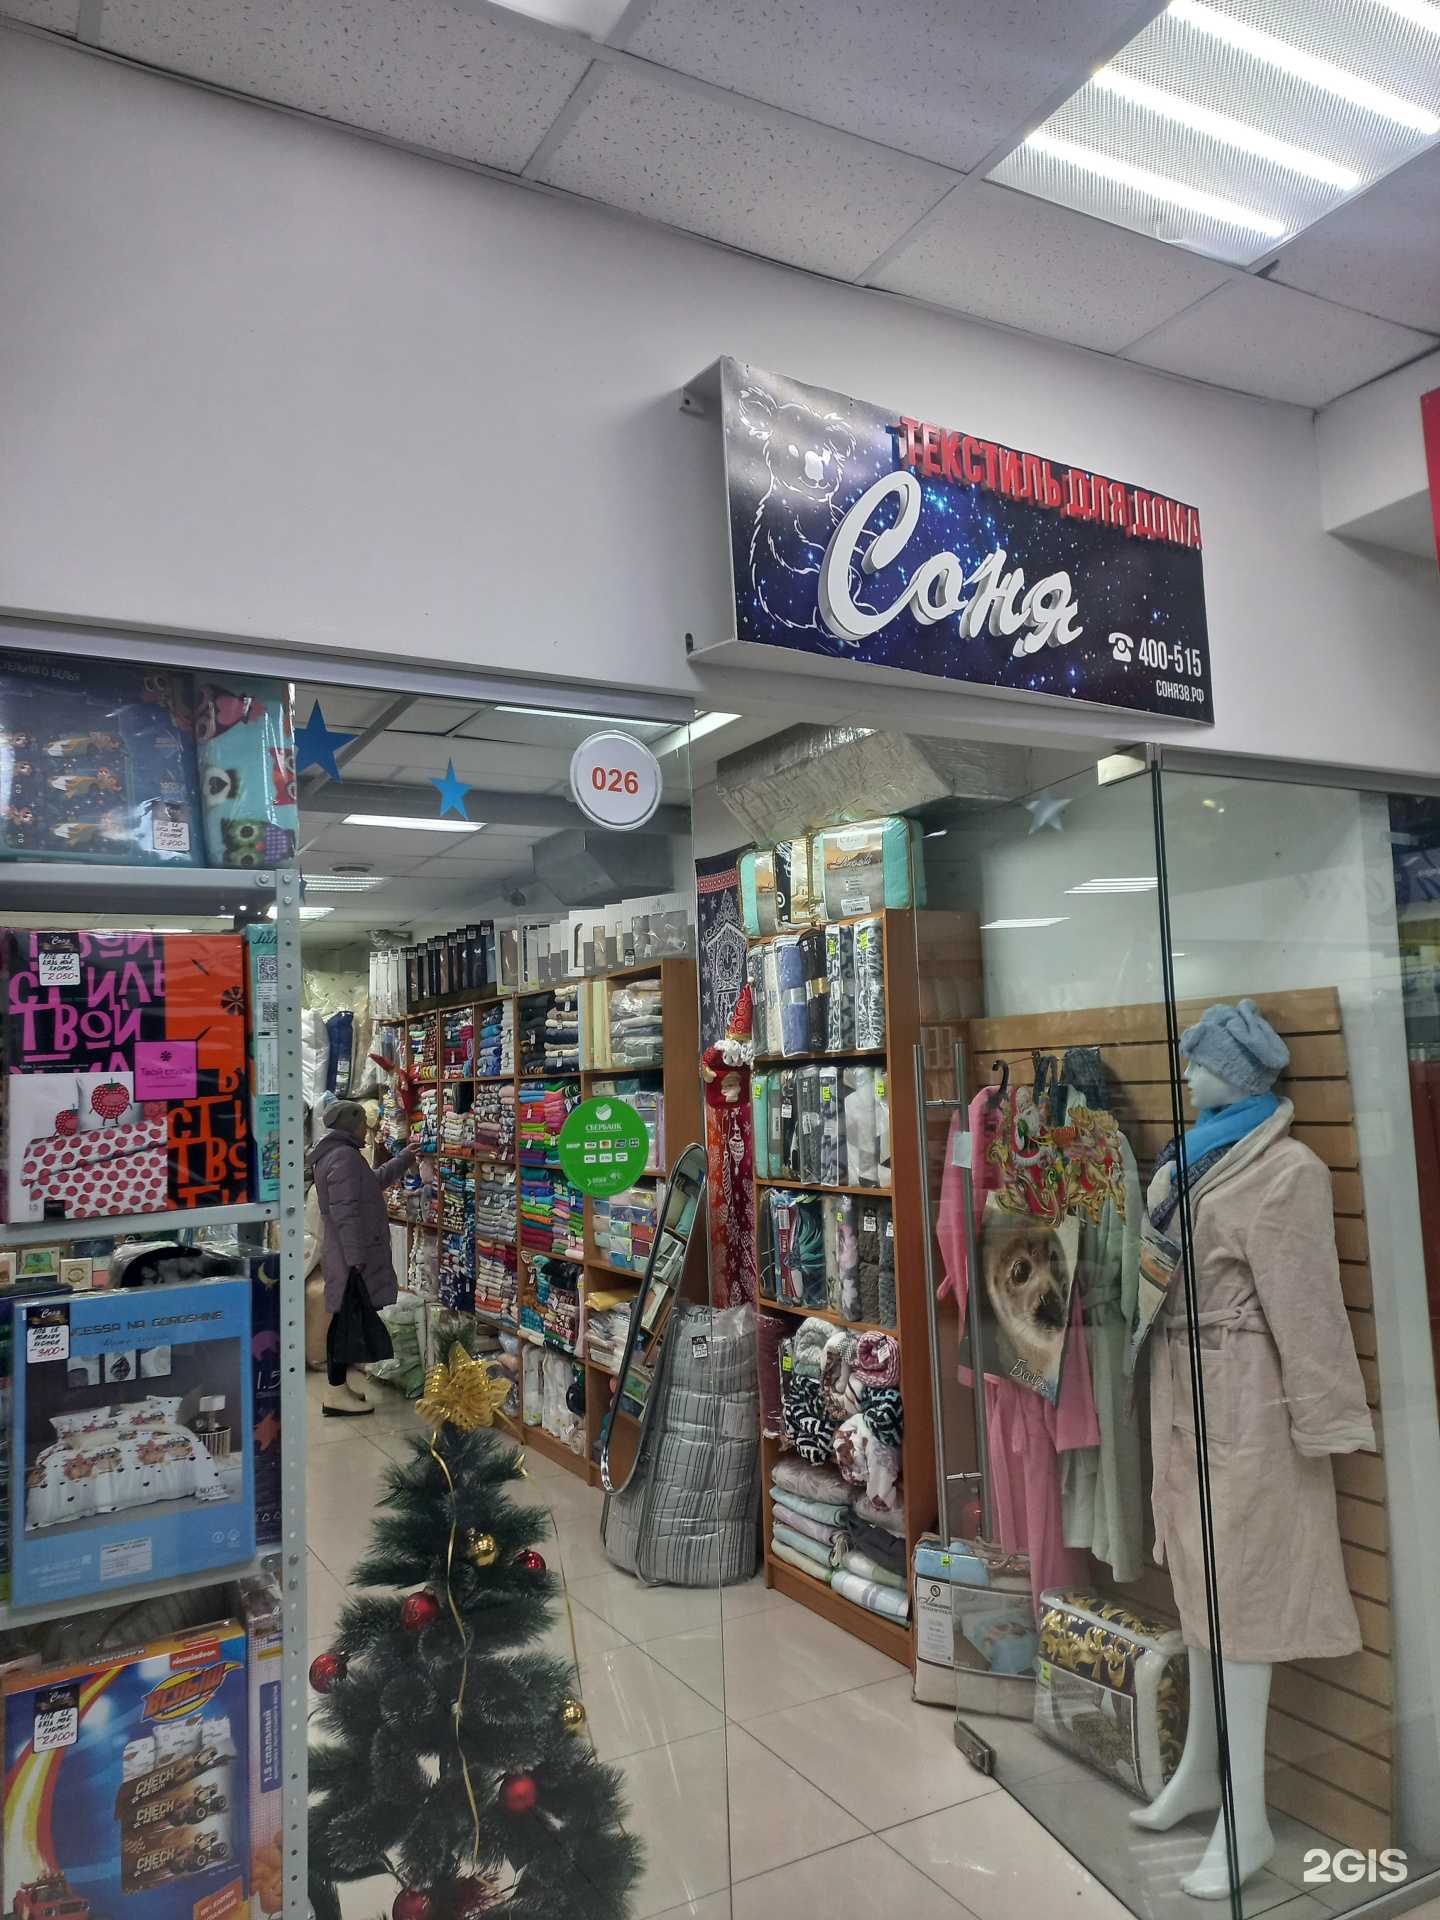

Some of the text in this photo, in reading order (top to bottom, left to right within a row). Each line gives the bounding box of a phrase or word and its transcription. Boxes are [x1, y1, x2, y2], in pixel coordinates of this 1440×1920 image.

[899, 415, 1202, 549] ТЕКСТИЛЬ ДЛЯ ДОМА
[818, 471, 1083, 657] Соня
[1139, 637, 1202, 678] 400-515
[1156, 679, 1205, 704] СОНЯ38.РФ
[592, 767, 639, 794] 026
